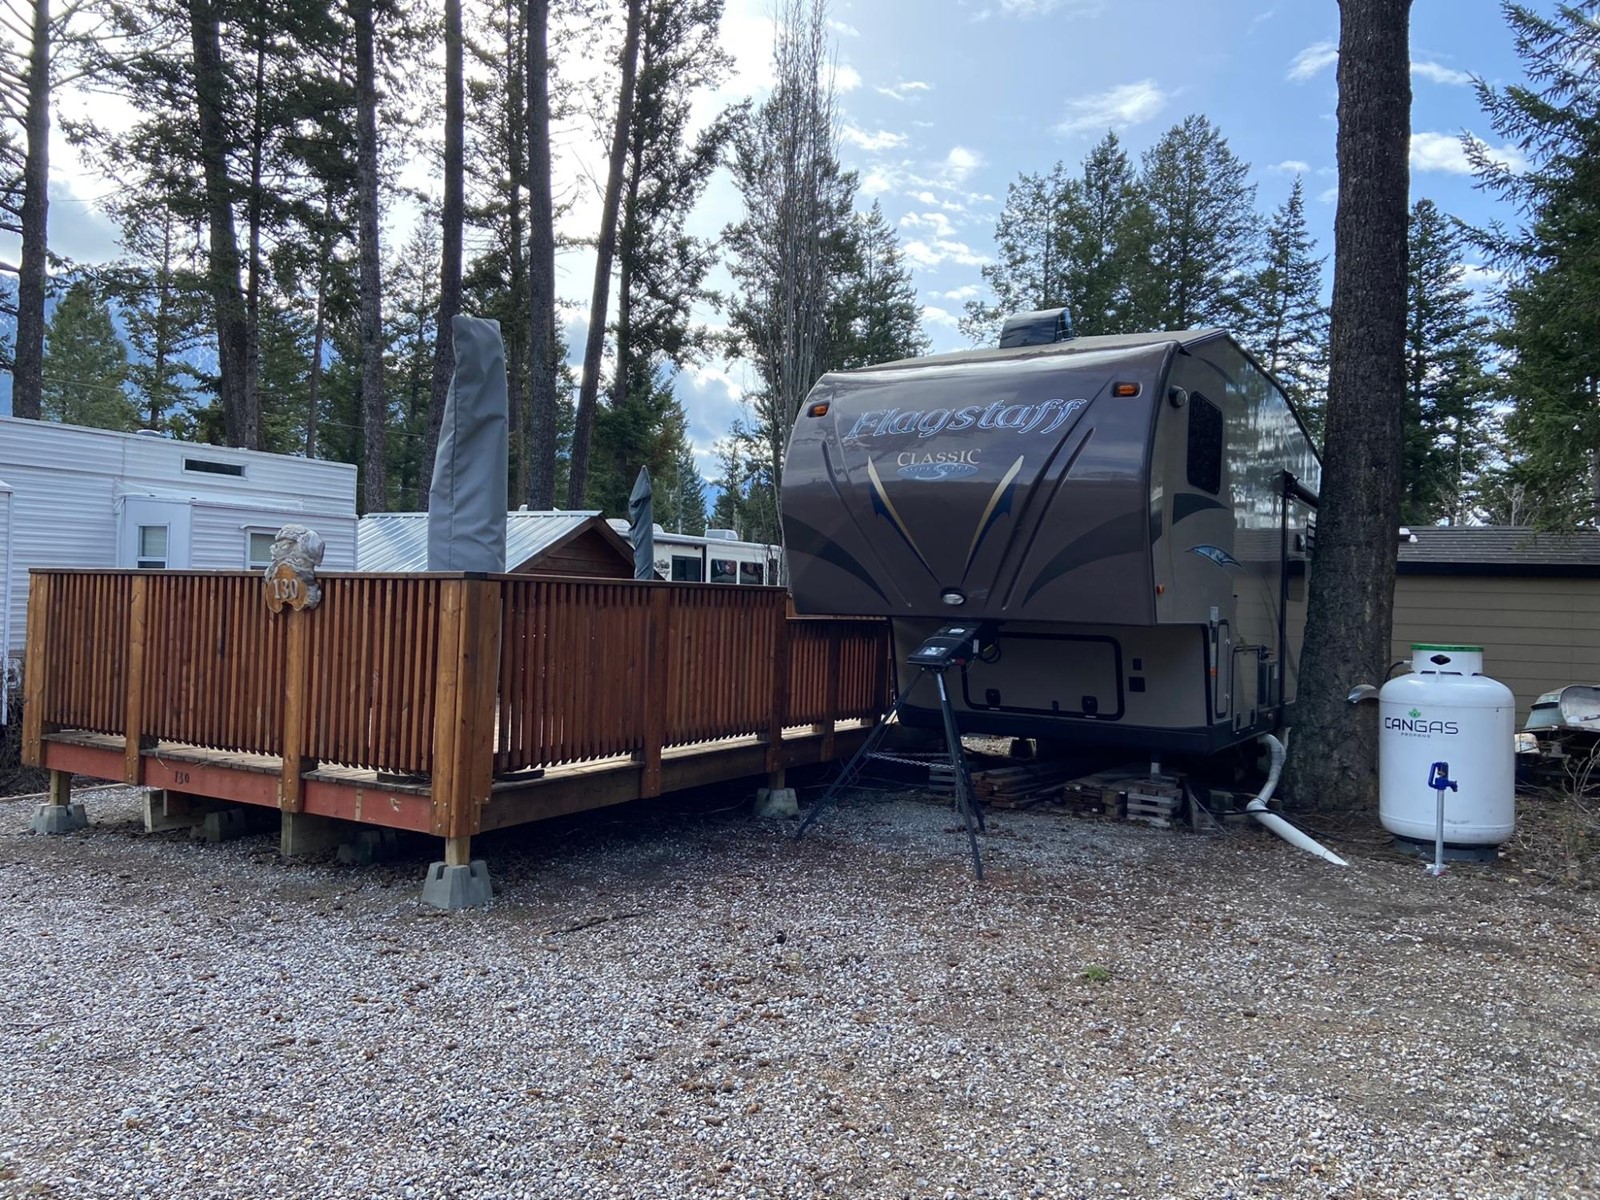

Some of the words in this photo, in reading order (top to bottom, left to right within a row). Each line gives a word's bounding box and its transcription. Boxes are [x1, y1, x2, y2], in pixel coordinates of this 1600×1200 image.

[844, 398, 1087, 440] Flagstaff
[897, 448, 982, 467] CLASSIC
[273, 578, 299, 599] 130
[1384, 717, 1459, 735] CANGAS
